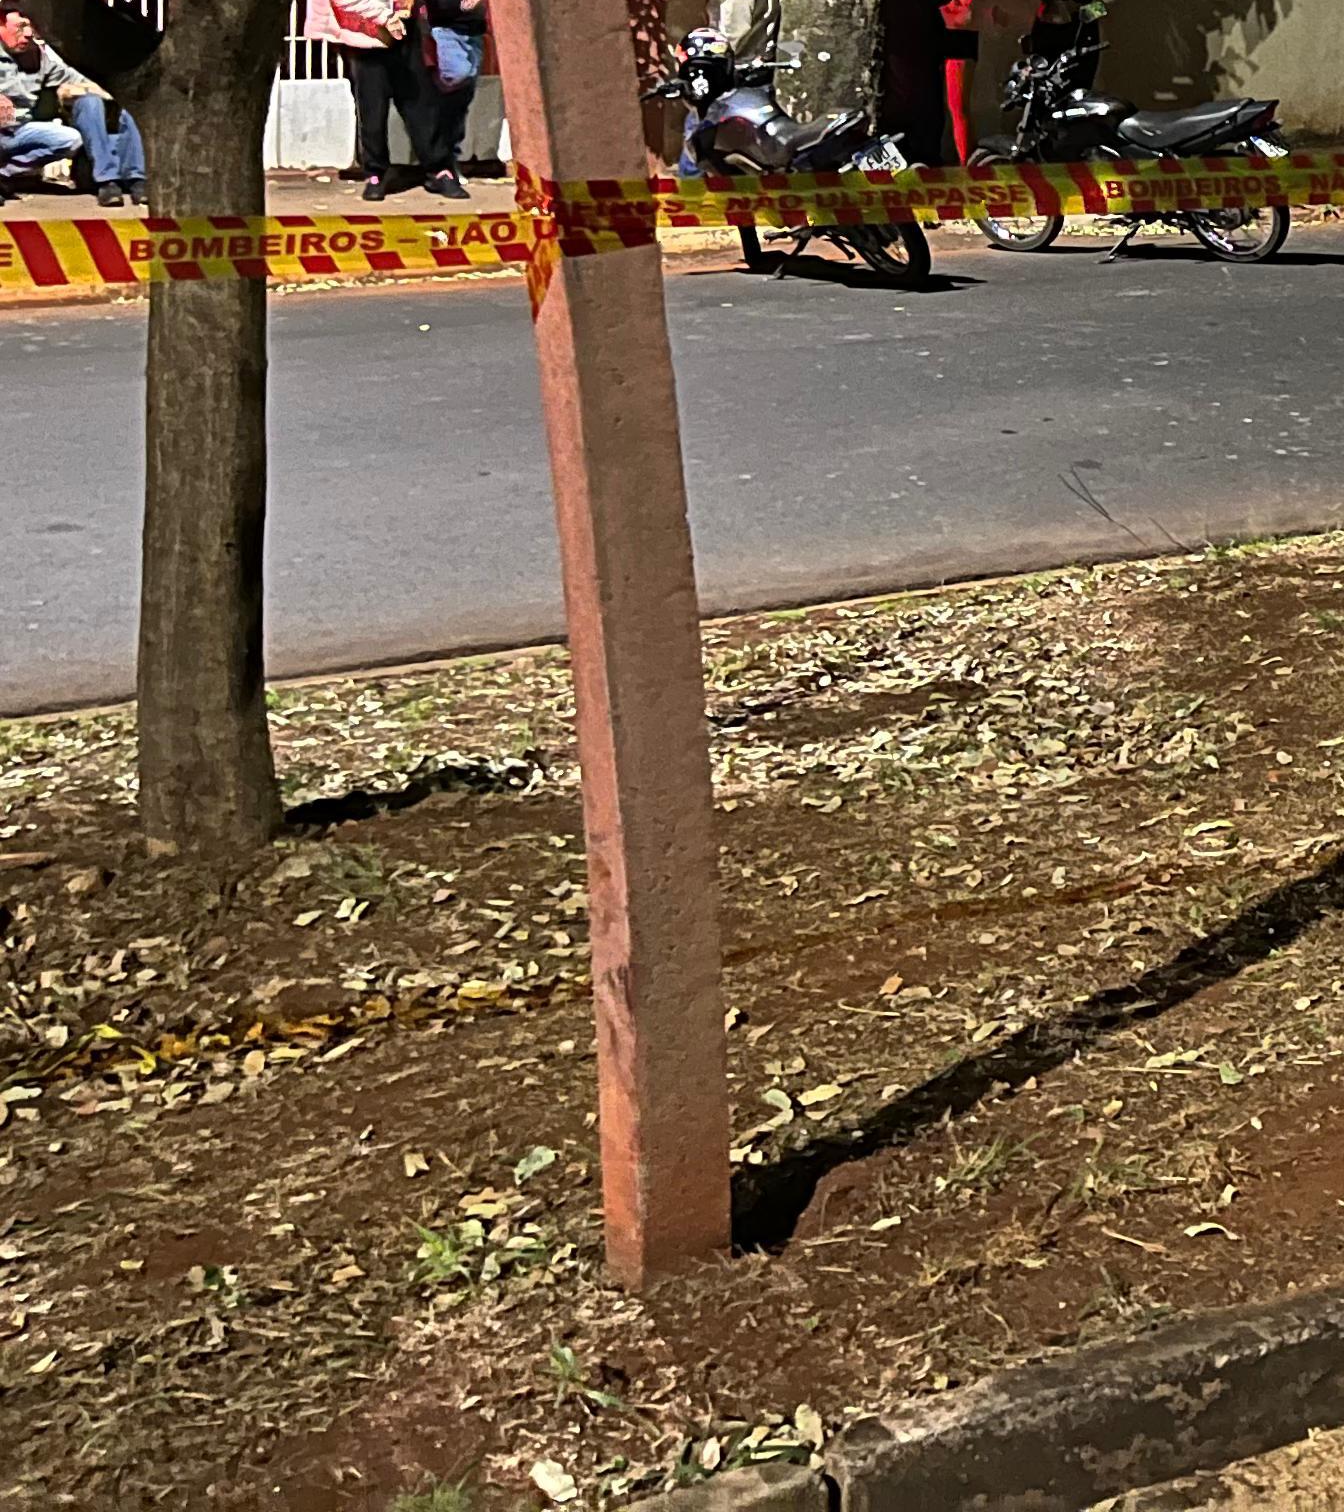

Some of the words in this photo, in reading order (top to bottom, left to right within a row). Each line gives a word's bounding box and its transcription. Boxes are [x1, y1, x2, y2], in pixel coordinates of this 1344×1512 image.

[815, 184, 1029, 208] ULTRAPASSE
[1105, 175, 1281, 198] BOMBEIROS
[130, 230, 385, 262] BOMBEIROS
